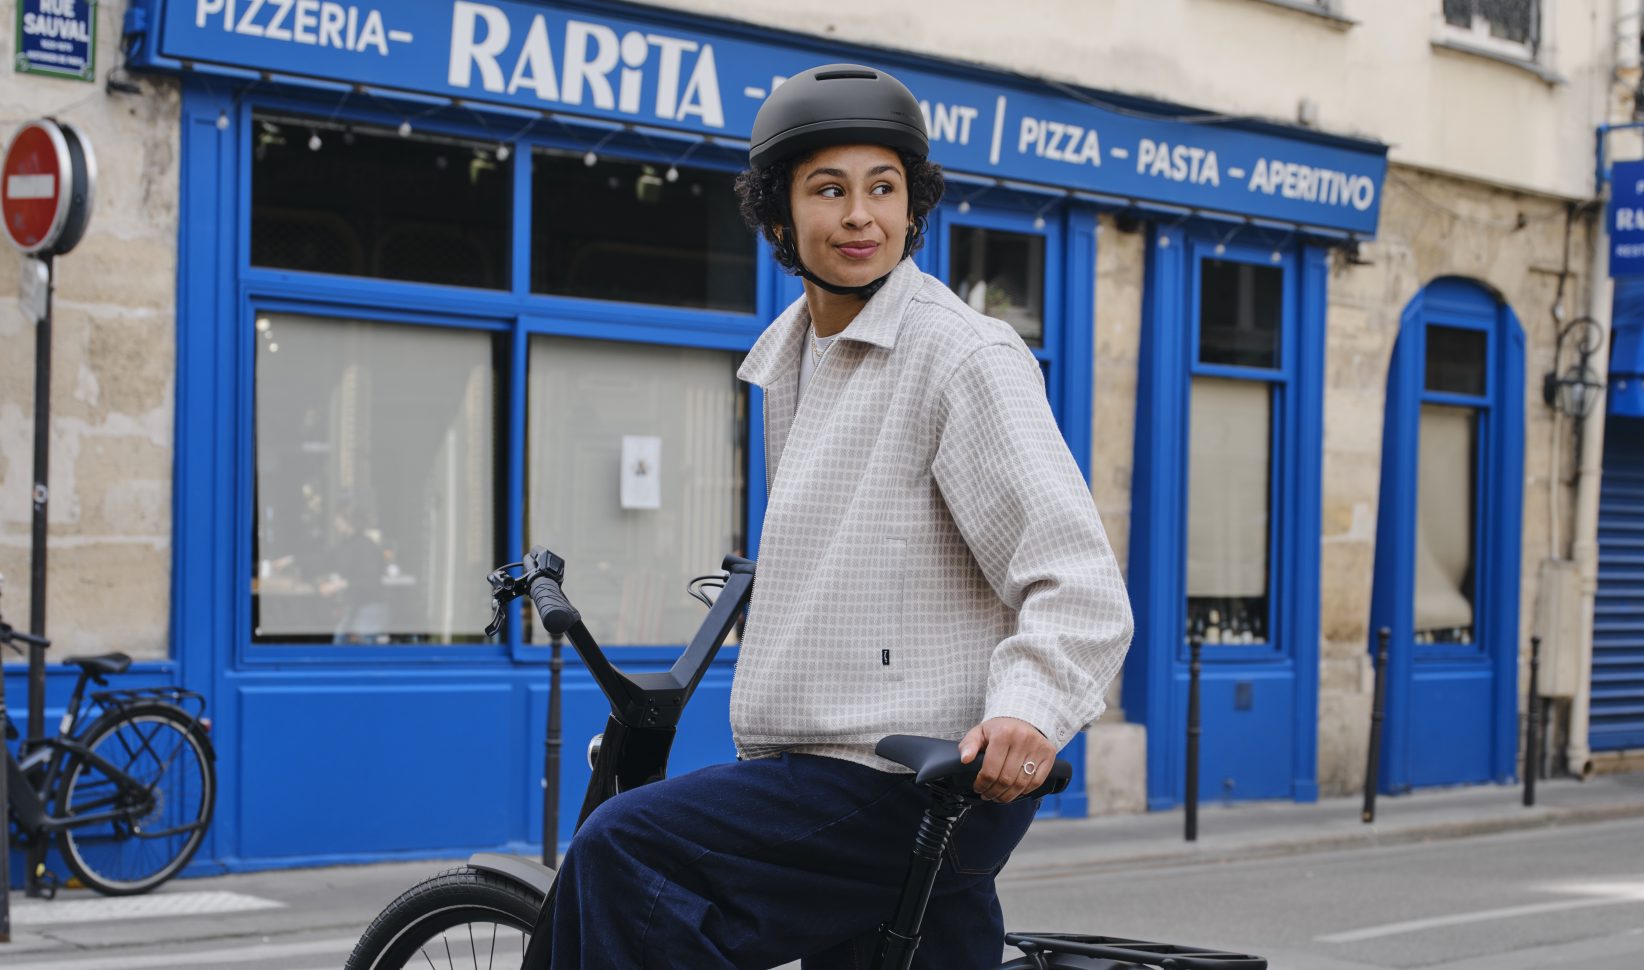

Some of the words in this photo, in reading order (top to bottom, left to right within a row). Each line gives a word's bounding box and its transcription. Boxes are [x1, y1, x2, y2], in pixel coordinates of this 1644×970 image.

[40, 0, 76, 18] RUE
[23, 12, 89, 43] SAUVAL
[1018, 117, 1101, 166] PIZZA
[1137, 139, 1220, 187] PASTA
[1248, 159, 1374, 211] APERITIVO
